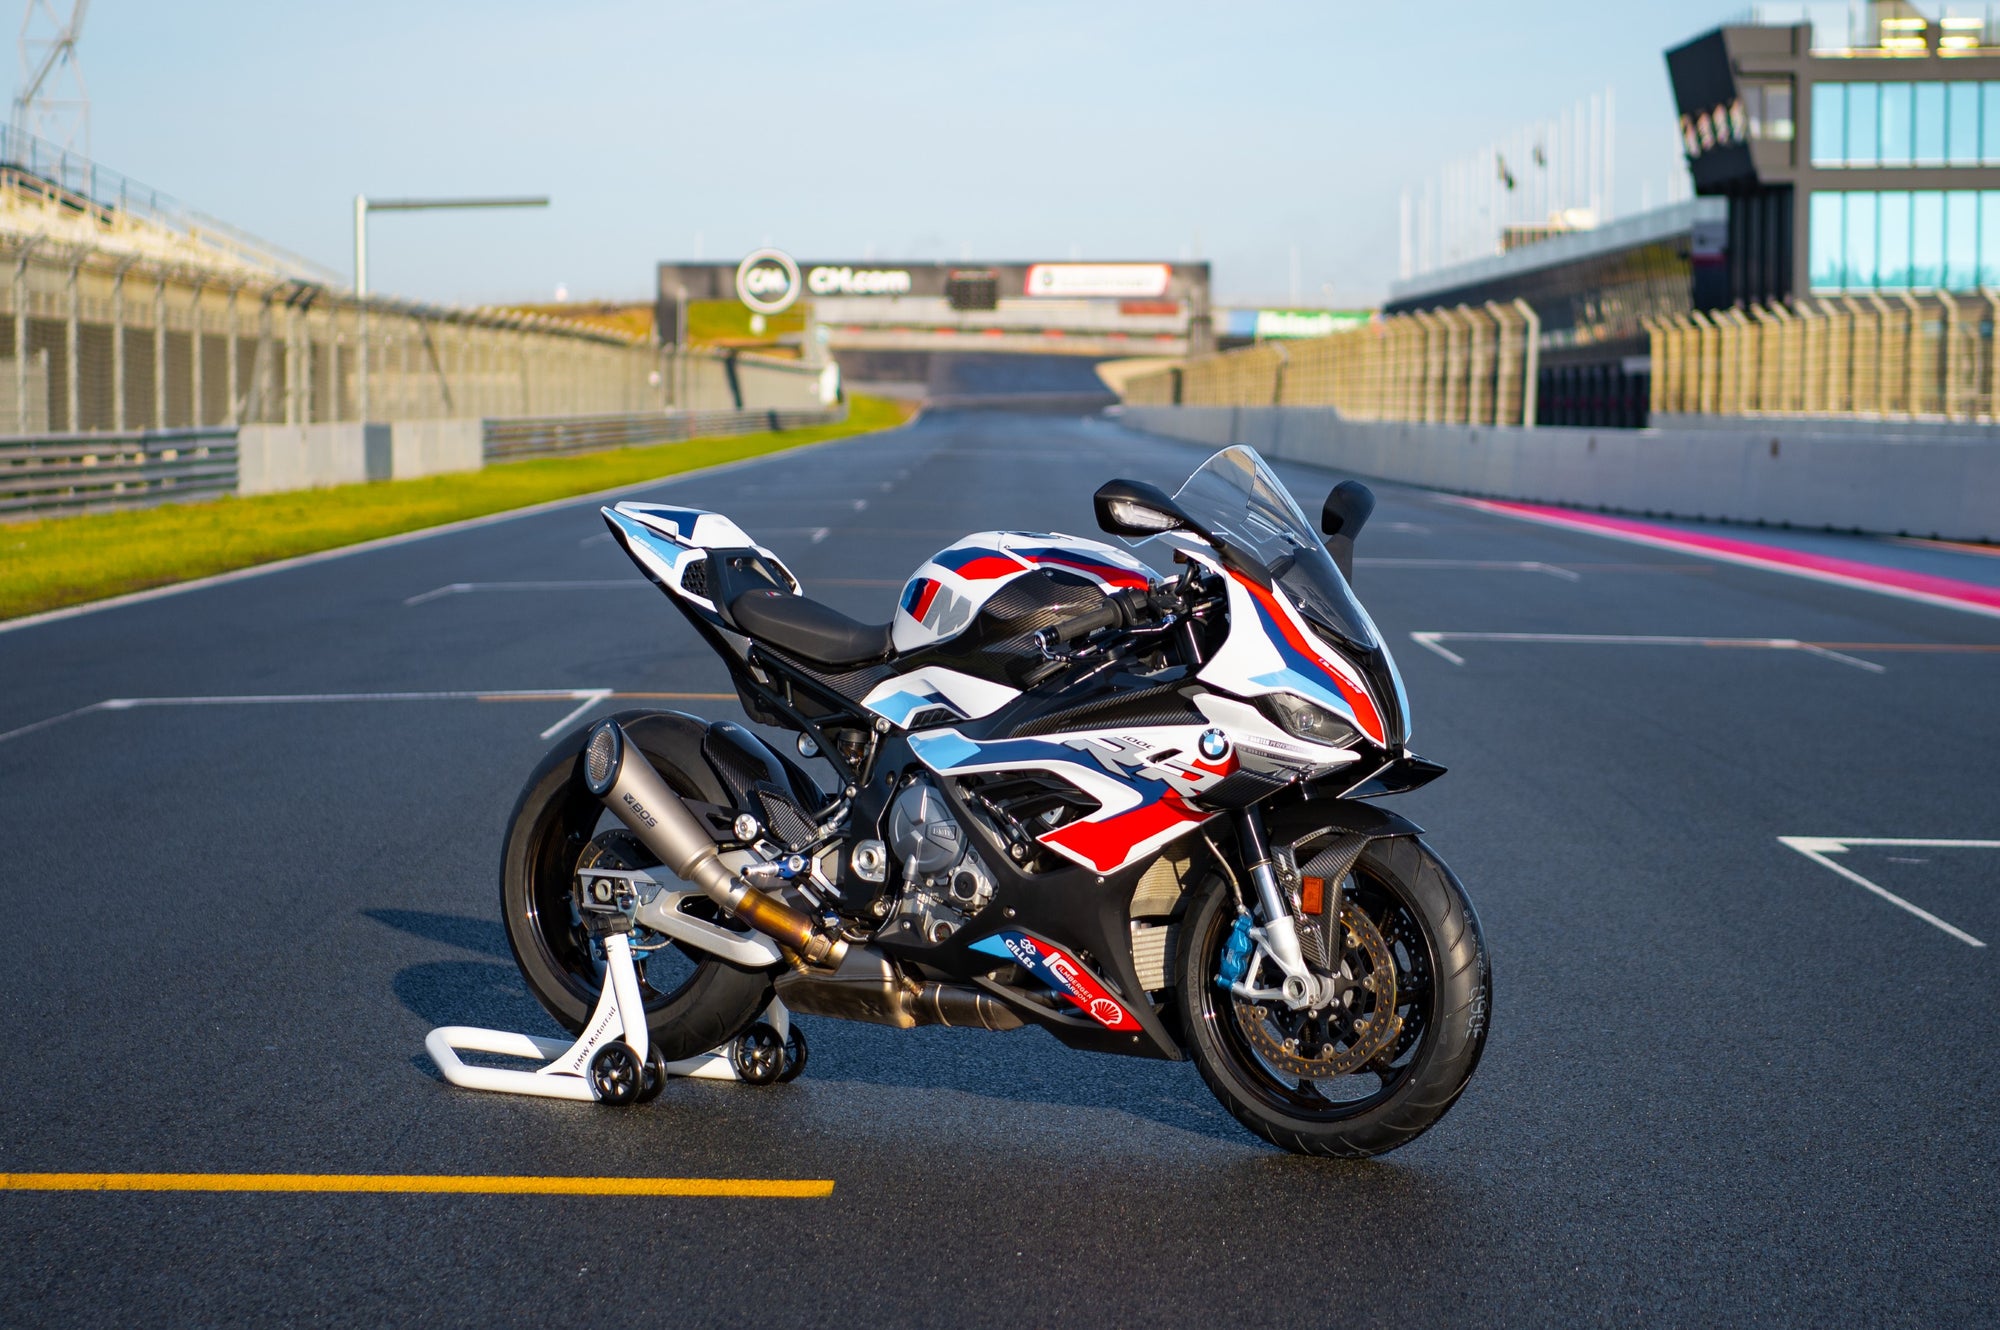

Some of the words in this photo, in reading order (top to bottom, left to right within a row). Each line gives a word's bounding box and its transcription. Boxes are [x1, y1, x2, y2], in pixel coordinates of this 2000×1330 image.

[632, 802, 658, 827] BOS
[1005, 938, 1036, 969] GILLES
[1058, 966, 1093, 999] ILMBERGER
[573, 1046, 590, 1071] BMW
[588, 1006, 617, 1047] Motorrad
